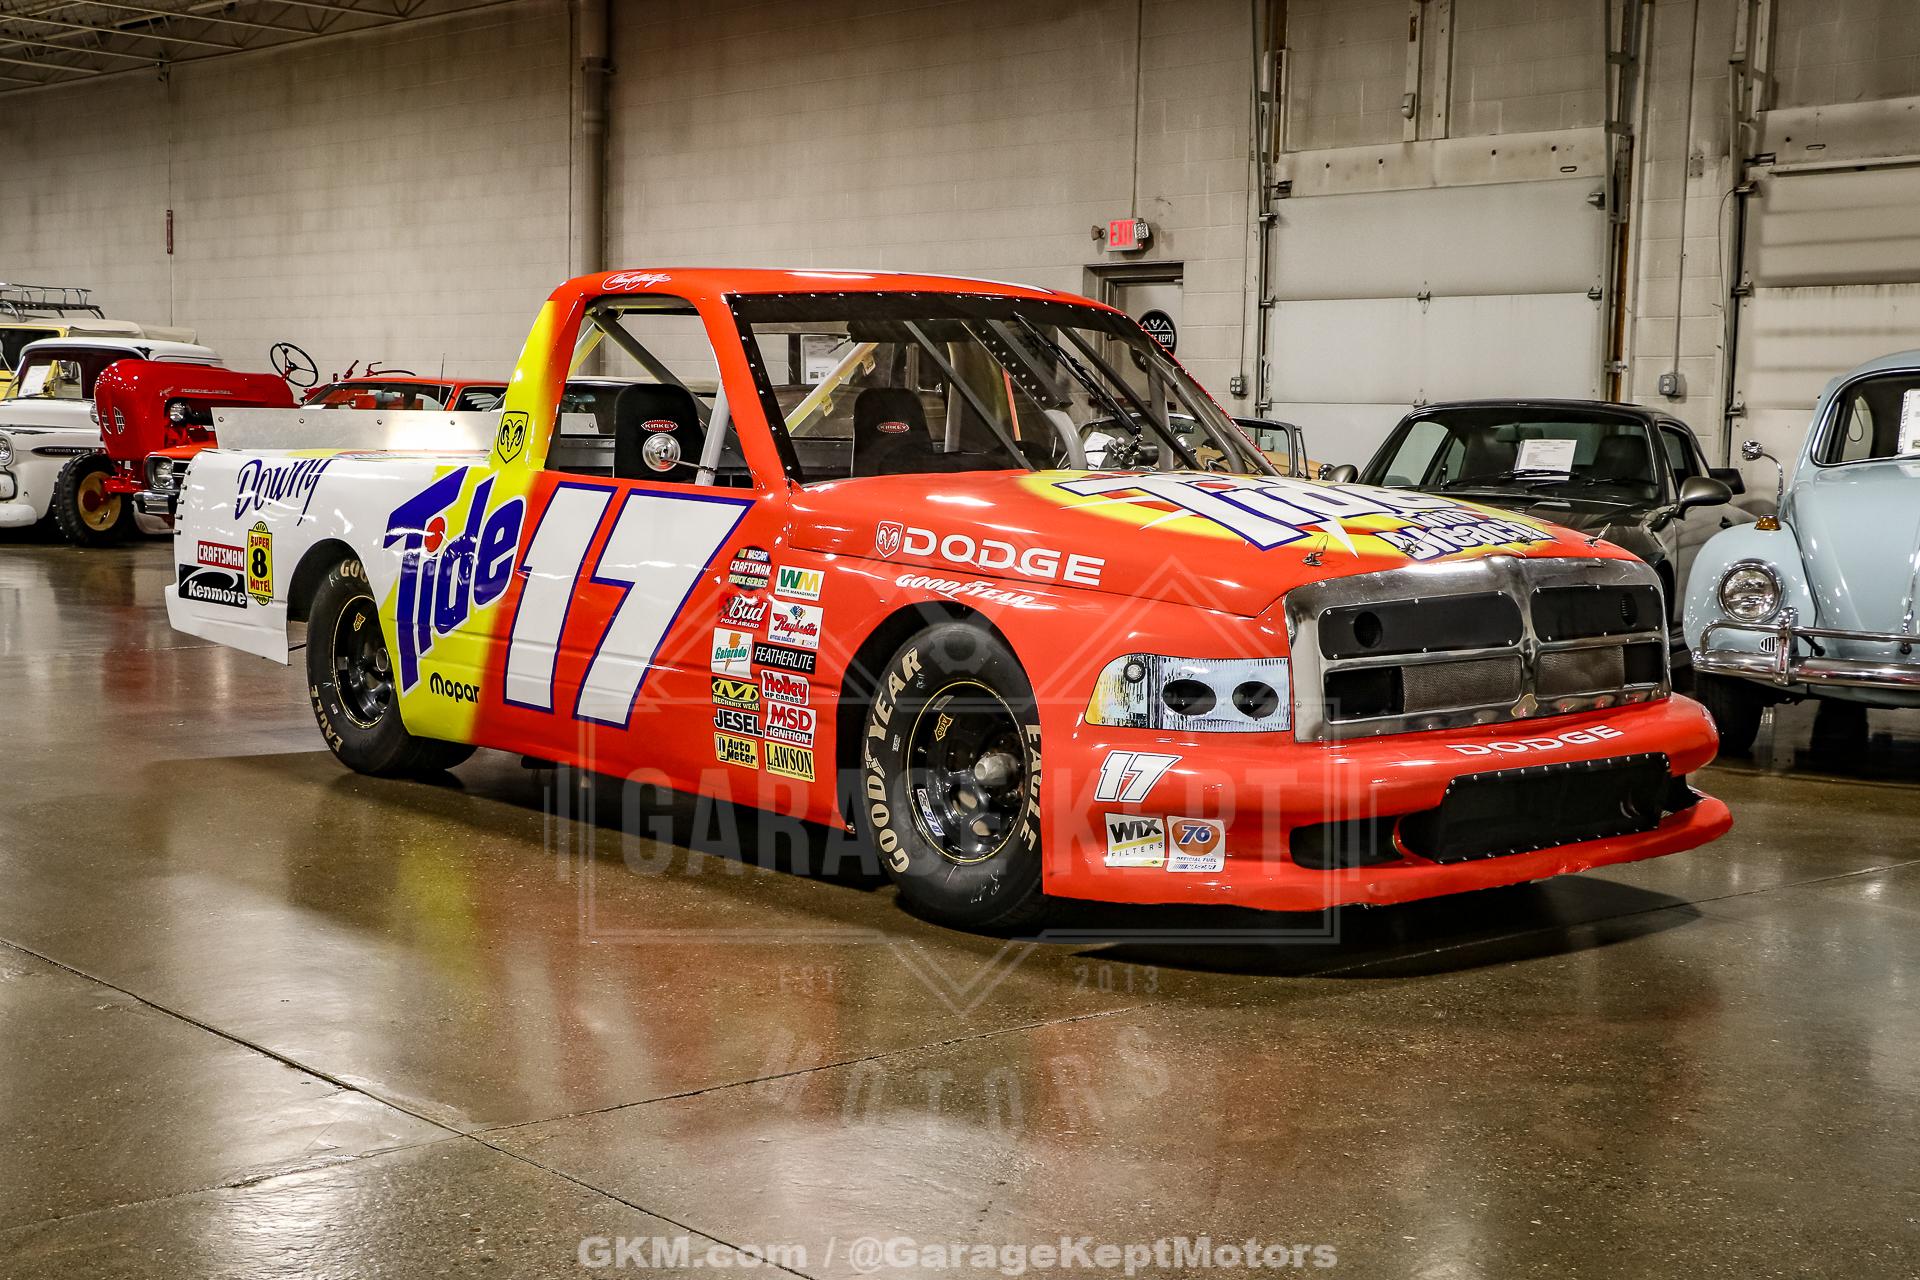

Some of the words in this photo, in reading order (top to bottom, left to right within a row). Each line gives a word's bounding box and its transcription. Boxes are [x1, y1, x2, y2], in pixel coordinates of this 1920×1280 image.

[1109, 220, 1136, 246] EXIT
[1158, 333, 1172, 343] KEPT
[644, 422, 676, 430] KIRKEY
[234, 459, 334, 527] Downy
[1051, 473, 1457, 551] Tide
[250, 535, 270, 550] SUPER
[198, 544, 244, 567] CRAFTSMAN
[251, 548, 268, 578] 8
[730, 560, 771, 575] CRAFTSMAN
[902, 526, 1105, 586] DODGE
[188, 579, 247, 605] Kenmore
[250, 575, 272, 593] MOTEL
[382, 465, 526, 696] Tide
[728, 573, 746, 584] TRUCK
[746, 577, 768, 587] SERIES
[780, 568, 819, 592] WM
[503, 481, 756, 731] 17
[729, 596, 768, 622] Bud
[720, 617, 736, 625] POLE
[738, 621, 760, 629] AWARD
[715, 646, 748, 660] Gatorade
[754, 646, 814, 670] FEATHERLITE
[763, 672, 807, 704] Holley
[765, 691, 774, 699] HP
[775, 694, 800, 704] CARBS
[712, 695, 742, 708] MECHANIX
[742, 703, 760, 711] WEAR
[311, 684, 343, 752] EAGLE
[714, 709, 763, 736] JESEL
[770, 704, 813, 731] MSD
[727, 738, 751, 752] Auto
[768, 727, 809, 744] IGNITION
[1446, 725, 1624, 756] DODGE
[726, 749, 756, 764] Meter
[766, 743, 813, 774] LAWSON
[867, 647, 922, 873] GOODYEAR
[1020, 724, 1042, 851] EAGLE
[1094, 750, 1183, 804] 17
[1109, 819, 1163, 844] WIX
[1179, 825, 1212, 845] 76
[1111, 842, 1164, 857] FILTERS
